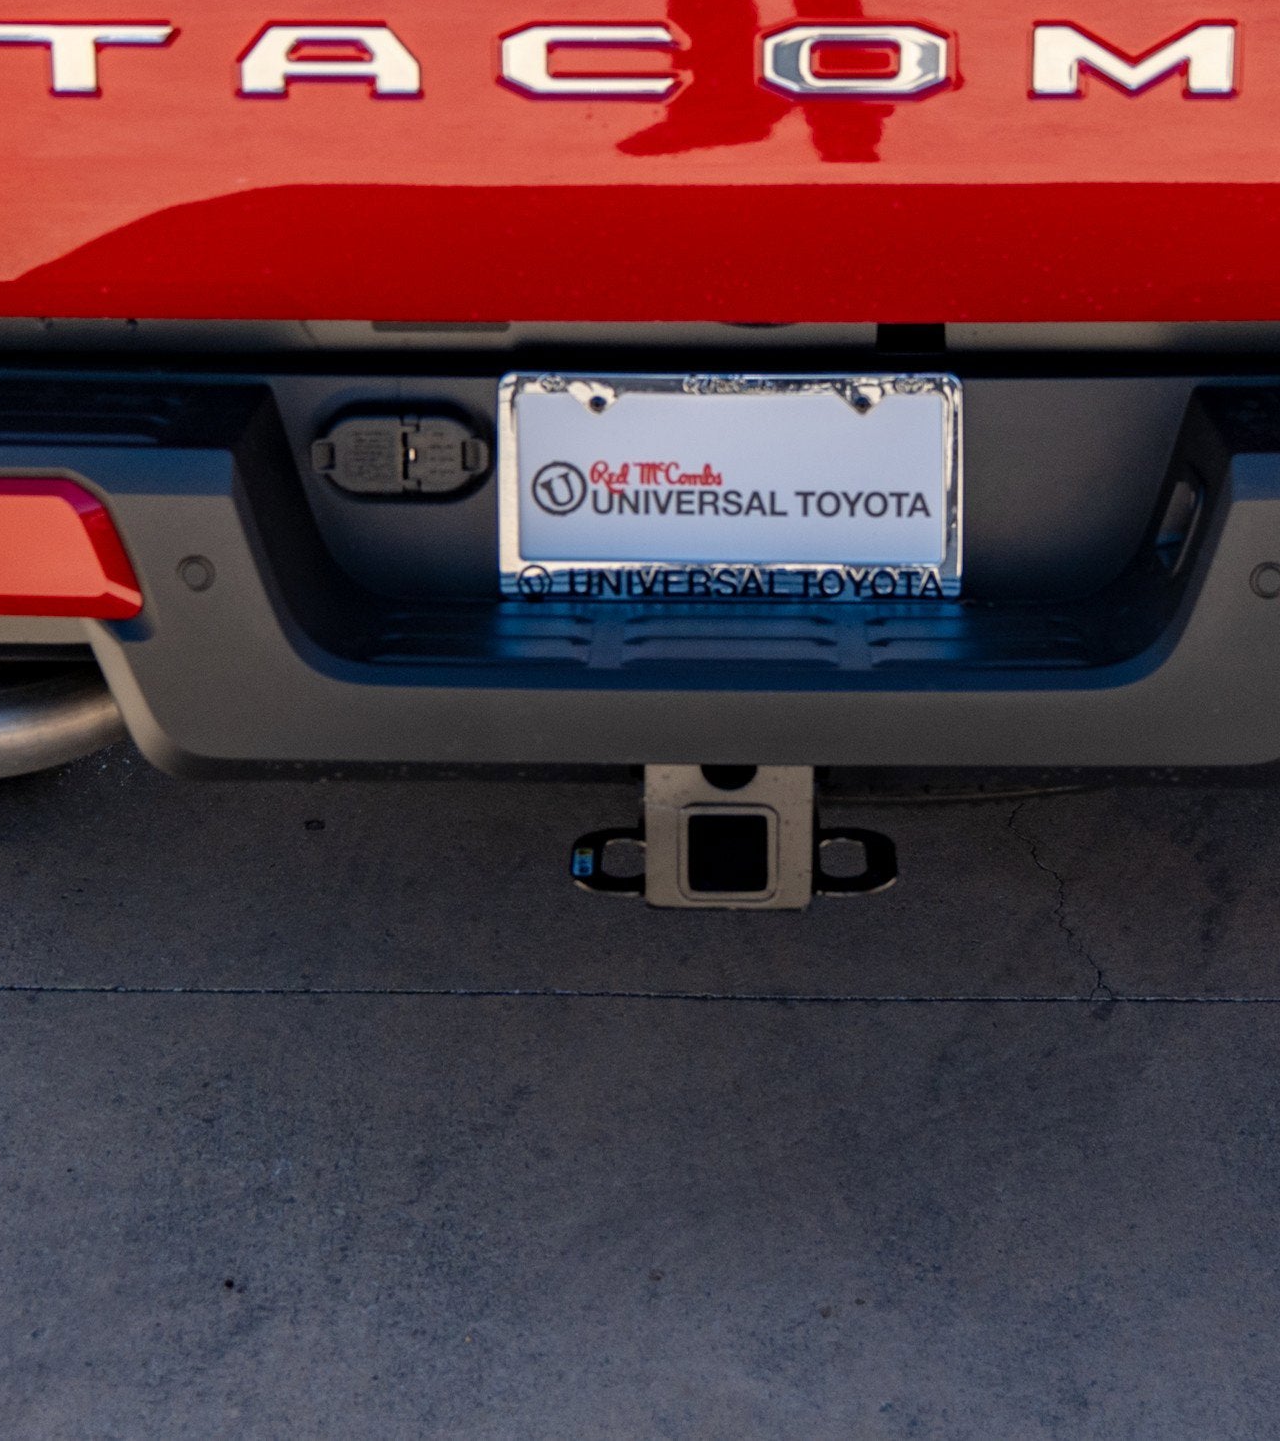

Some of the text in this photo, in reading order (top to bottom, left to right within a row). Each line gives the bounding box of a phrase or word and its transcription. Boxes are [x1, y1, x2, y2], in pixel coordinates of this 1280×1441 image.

[589, 460, 724, 494] Red McCombs
[592, 490, 932, 518] UNIVERSAL TOYOTA
[568, 568, 945, 598] UNIVERSAL TOYOTA
